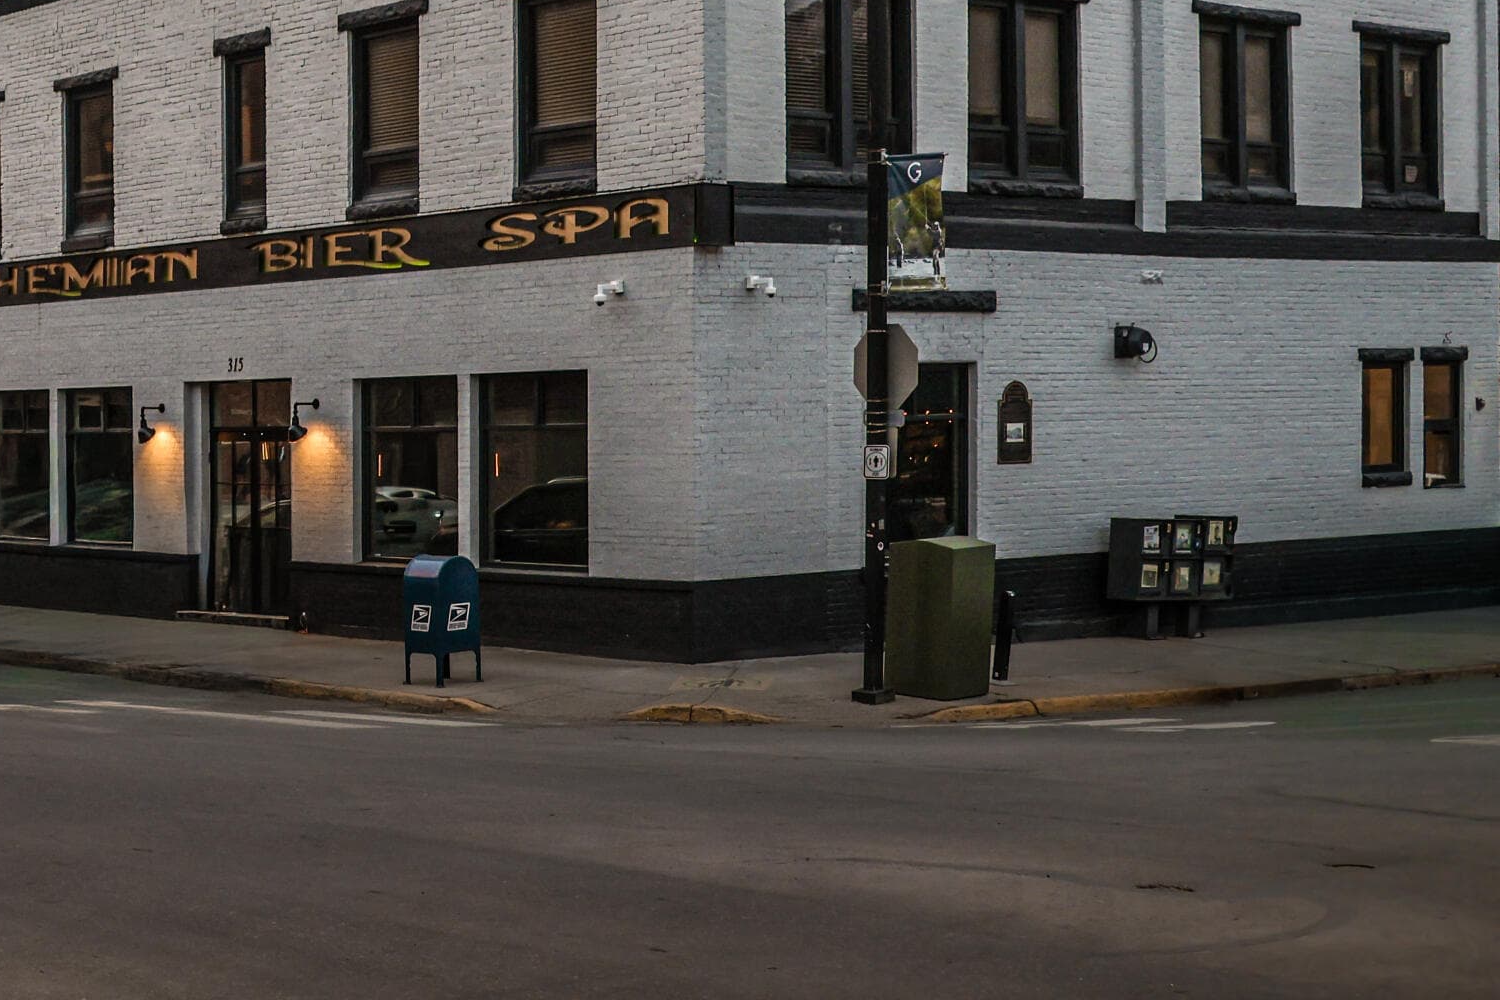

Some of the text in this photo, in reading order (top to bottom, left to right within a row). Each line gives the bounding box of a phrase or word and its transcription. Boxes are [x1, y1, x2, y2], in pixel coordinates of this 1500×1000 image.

[251, 227, 431, 273] BIER
[481, 198, 670, 252] SPA
[227, 357, 244, 372] 315
